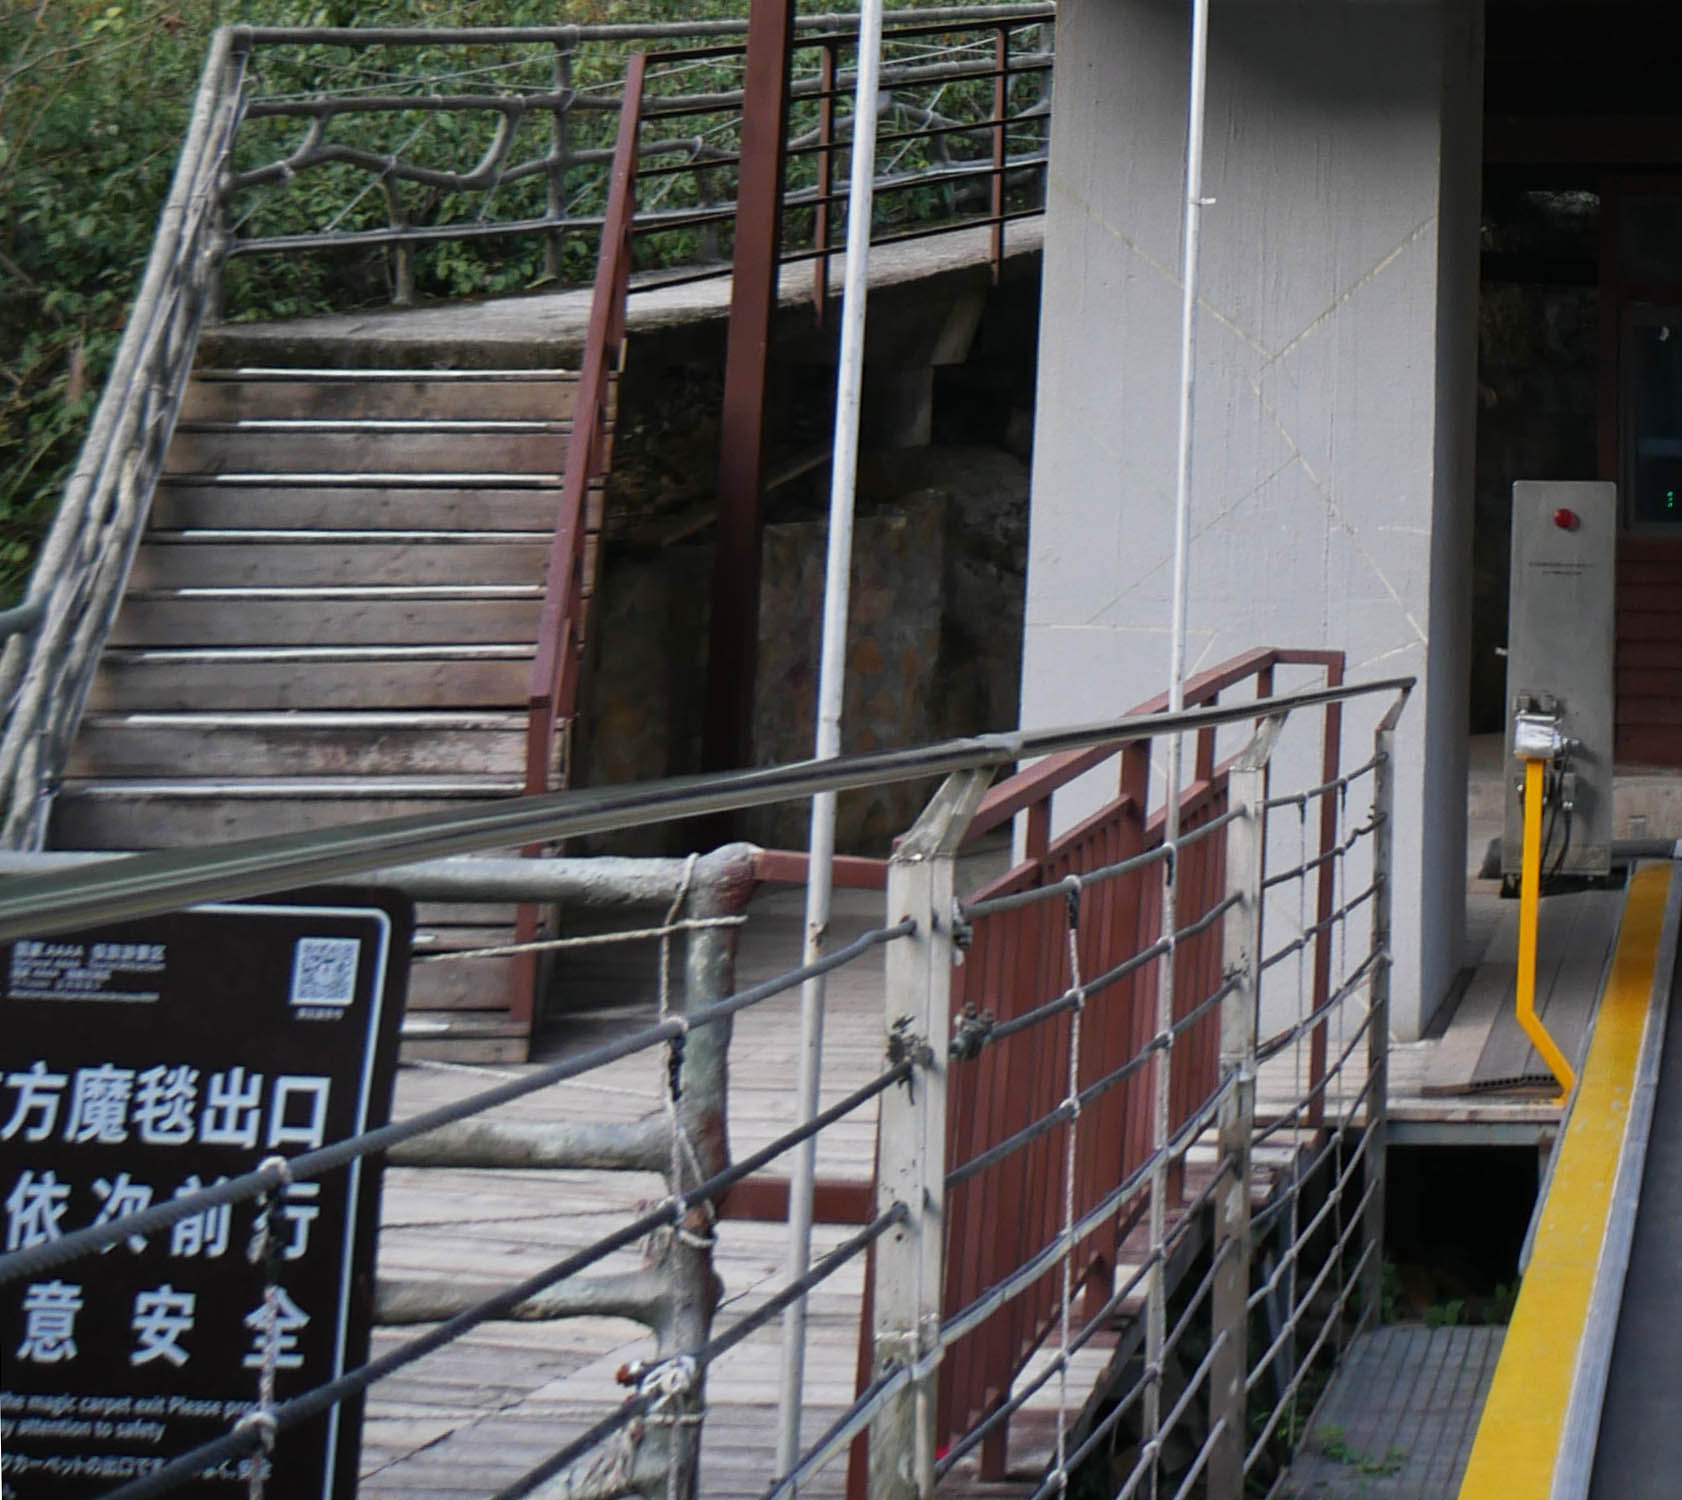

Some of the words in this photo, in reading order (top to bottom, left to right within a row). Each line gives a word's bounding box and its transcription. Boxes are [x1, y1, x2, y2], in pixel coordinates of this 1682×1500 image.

[0, 1060, 331, 1149] 方魔毯出口
[6, 1169, 320, 1263] 依次前行
[15, 1279, 311, 1368] 意安全
